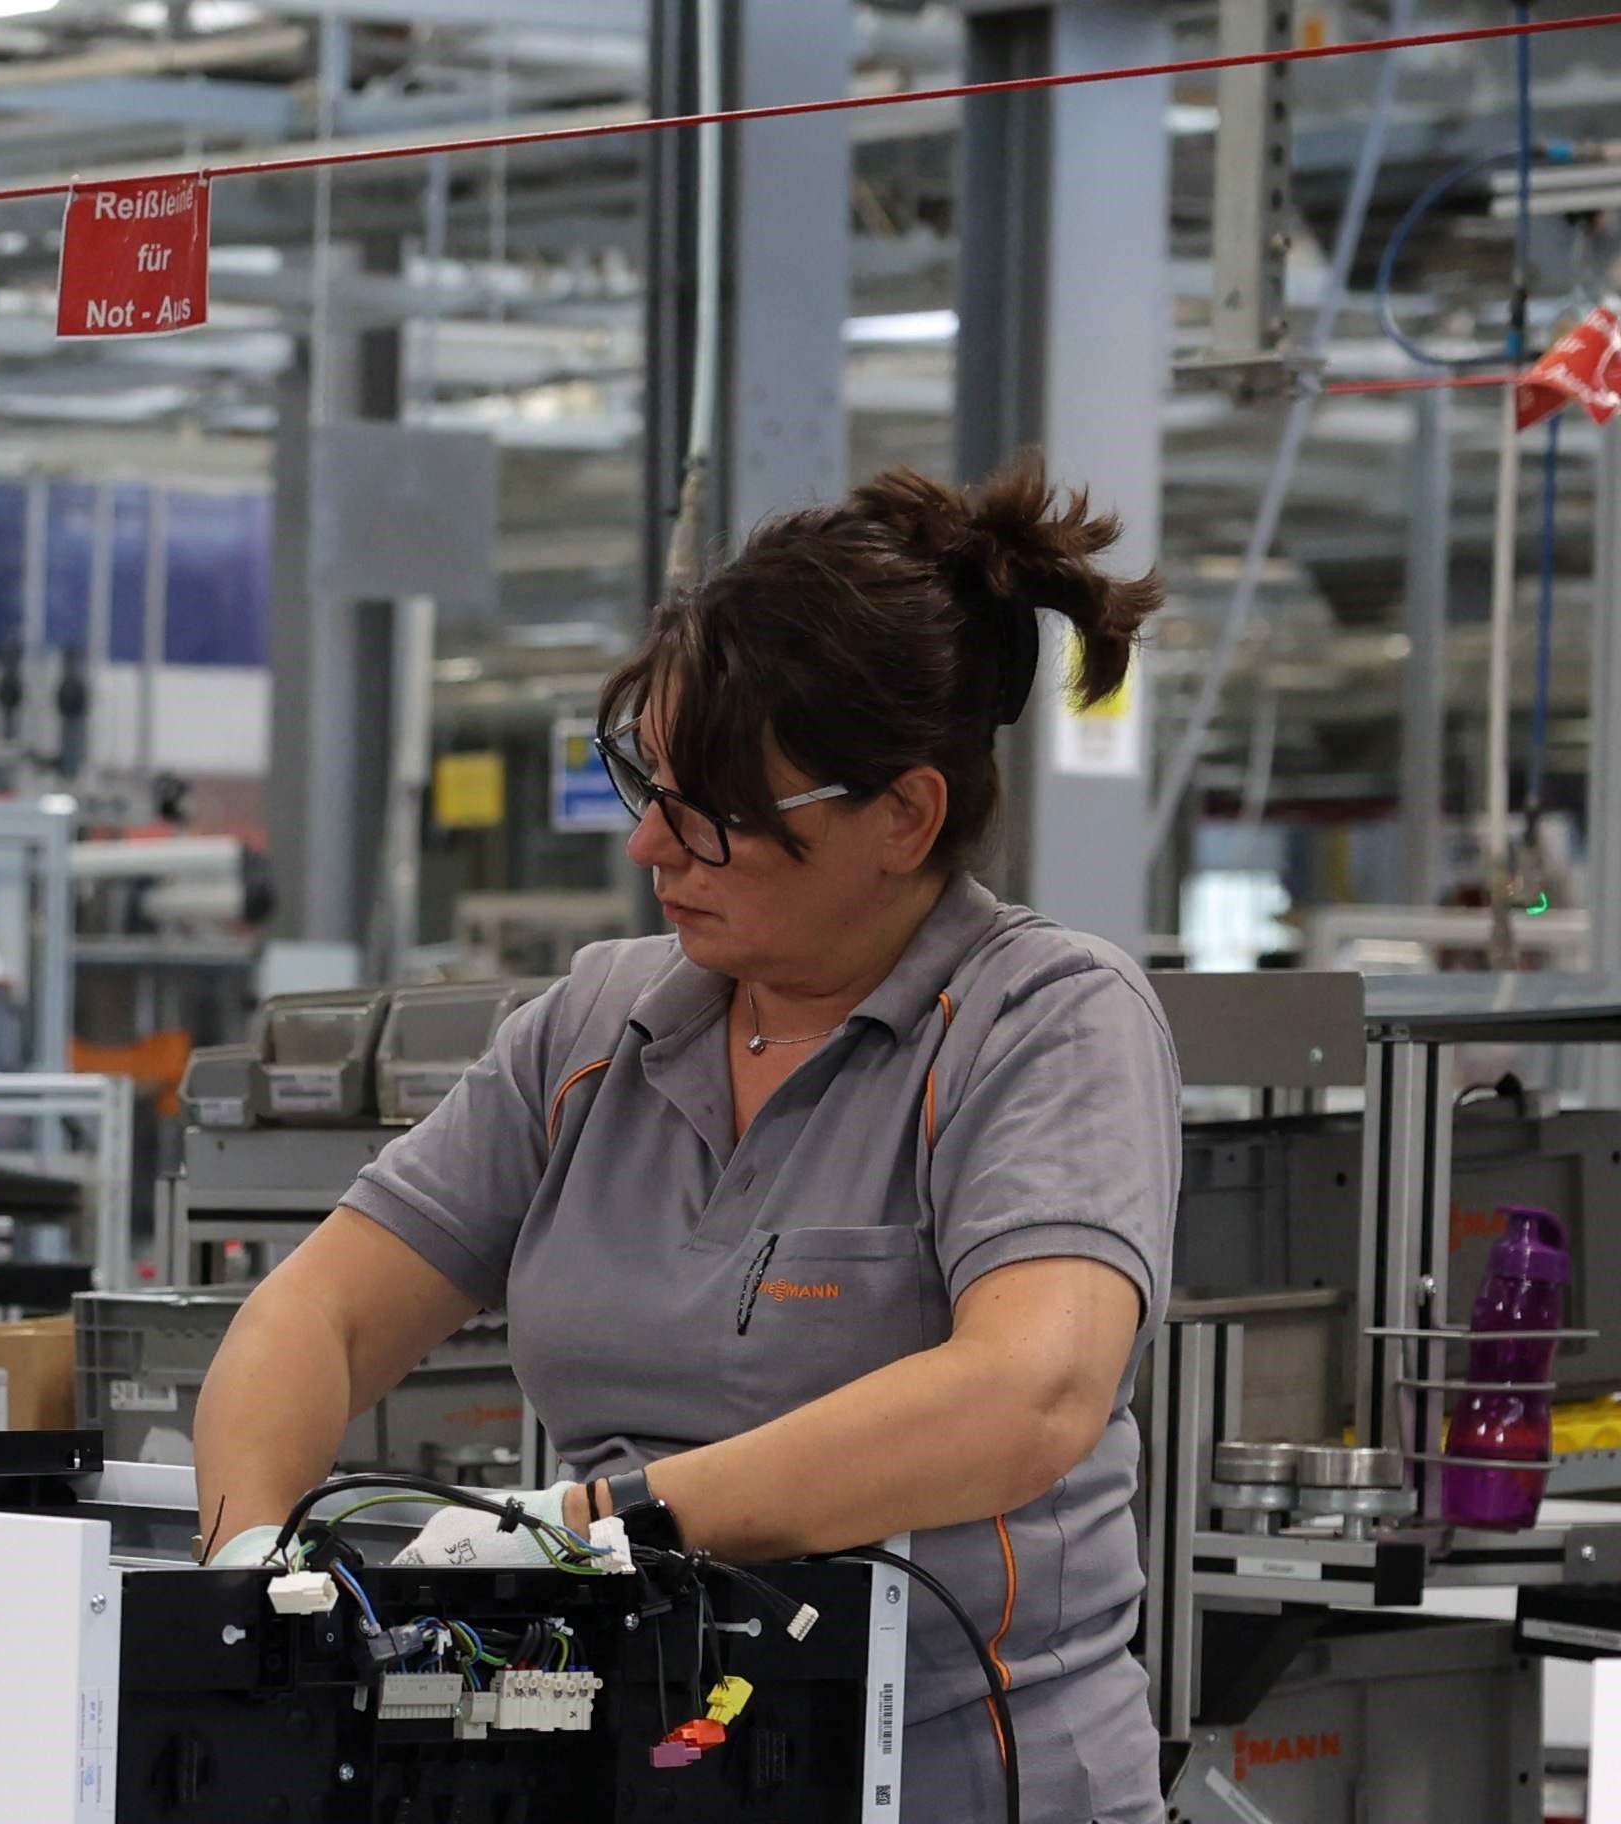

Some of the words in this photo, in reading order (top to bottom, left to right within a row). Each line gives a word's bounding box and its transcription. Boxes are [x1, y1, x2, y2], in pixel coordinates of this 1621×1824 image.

[94, 180, 194, 220] Reißleine
[137, 243, 172, 273] für
[85, 299, 136, 329] Not
[155, 295, 192, 325] Aus
